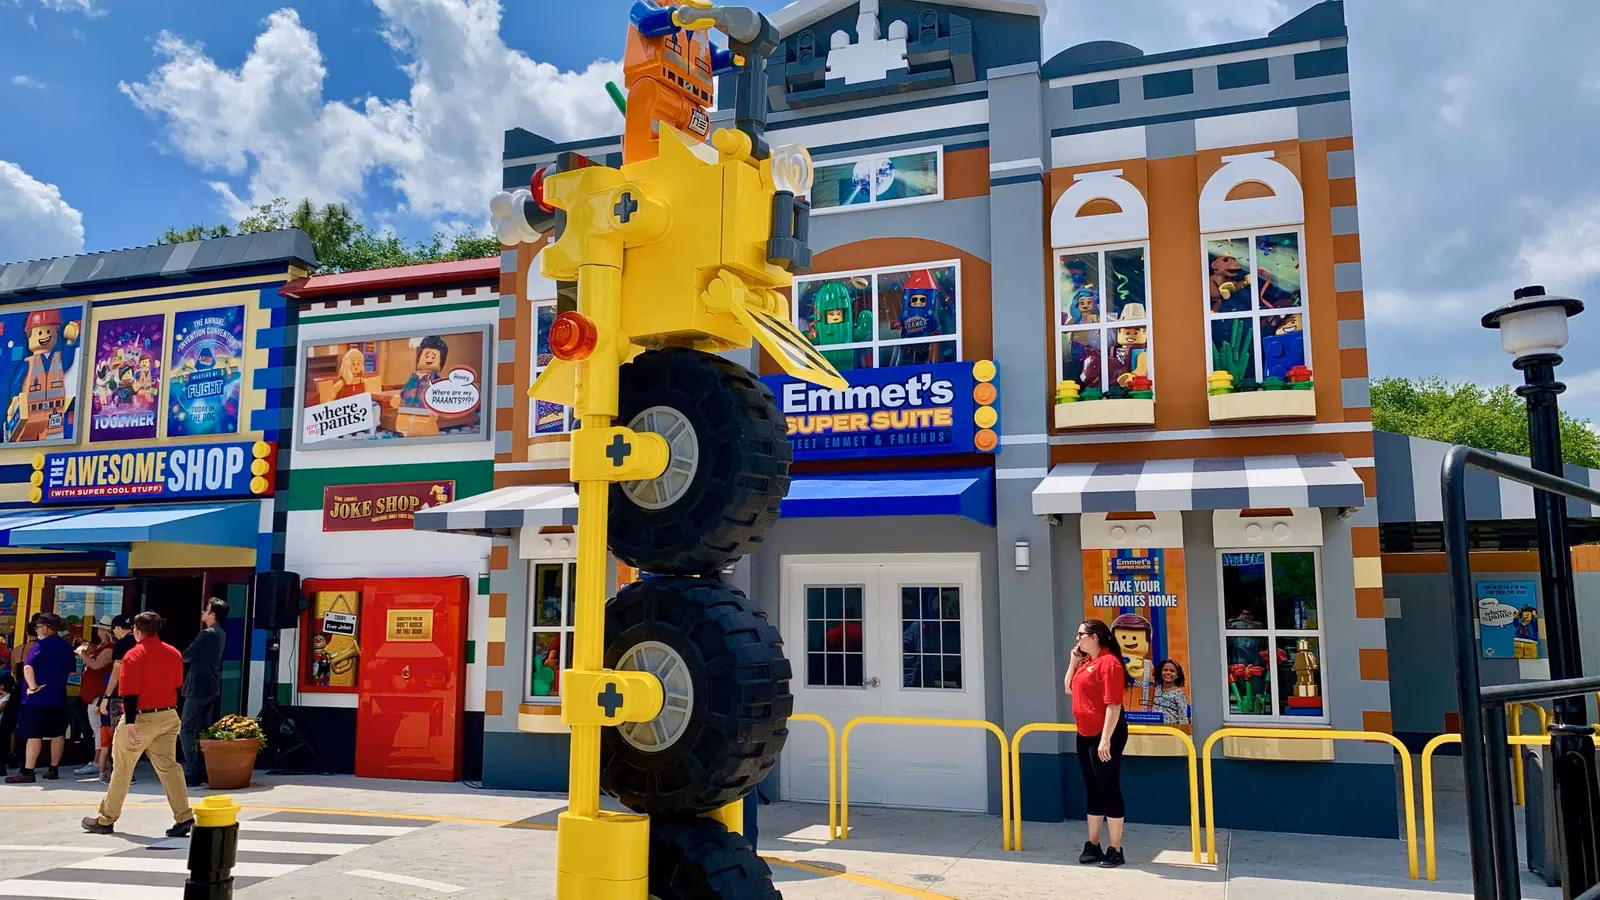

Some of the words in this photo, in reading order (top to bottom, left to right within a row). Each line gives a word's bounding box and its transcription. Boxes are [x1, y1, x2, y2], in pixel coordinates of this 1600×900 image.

[193, 318, 204, 329] THE
[204, 316, 225, 326] ANNUAL
[179, 328, 206, 350] INVENTION
[206, 326, 236, 346] CONVENTION
[187, 380, 223, 399] FLIGHT
[783, 373, 954, 414] Emmet's
[191, 405, 208, 414] TODAY
[191, 413, 201, 423] THE
[202, 412, 216, 422] DOG
[312, 402, 358, 422] where
[92, 411, 155, 430] TOGETHER
[319, 407, 367, 436] pants?
[786, 411, 871, 436] SUPER
[871, 407, 953, 431] SUITE
[308, 428, 320, 436] my
[825, 436, 867, 448] EMMET
[874, 435, 882, 445] &
[890, 431, 945, 445] FRIENDS
[49, 457, 65, 488] THE
[64, 452, 167, 487] AWESOME
[168, 446, 245, 492] SHOP
[51, 489, 75, 497] (WITH
[77, 488, 105, 496] SUPER
[107, 486, 130, 494] COOL
[131, 485, 162, 493] STUFF)
[329, 500, 372, 519] JOKE
[375, 495, 420, 514] SHOP
[1116, 558, 1151, 566] Emmet's
[1108, 580, 1132, 593] TAKE
[1133, 580, 1161, 593] YOUR
[1093, 594, 1146, 607] MEMORIES
[1148, 594, 1178, 607] HOME
